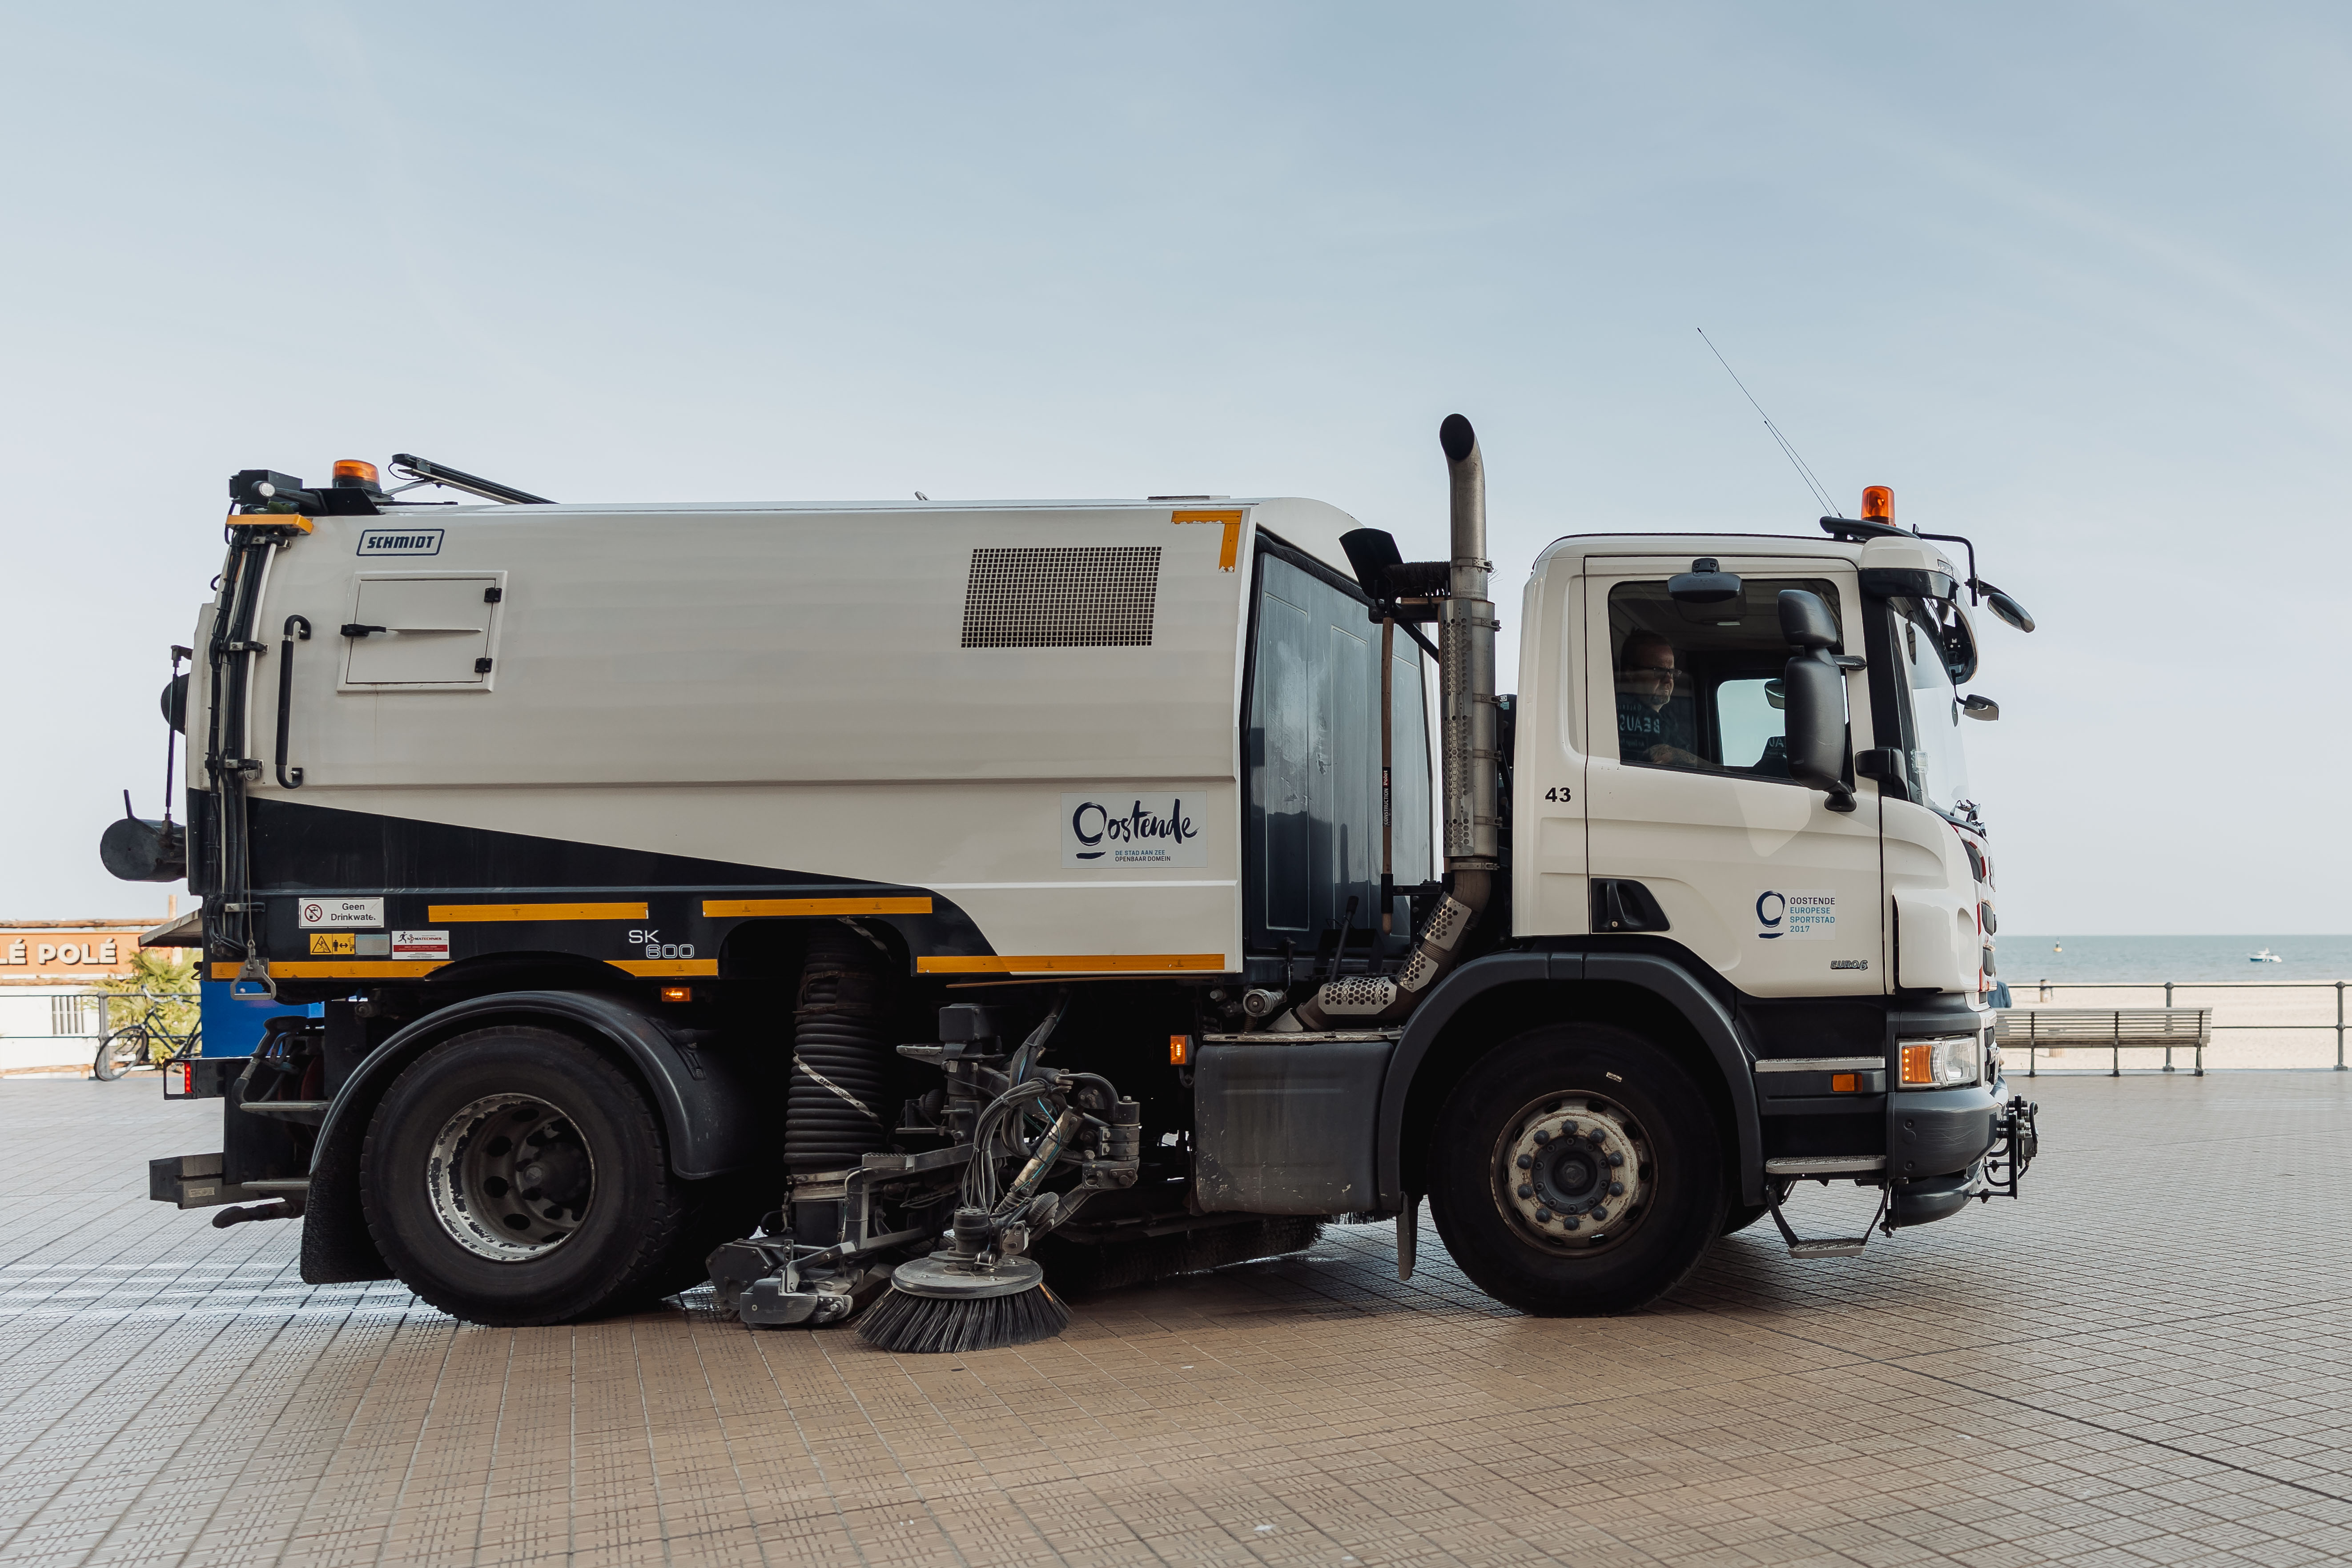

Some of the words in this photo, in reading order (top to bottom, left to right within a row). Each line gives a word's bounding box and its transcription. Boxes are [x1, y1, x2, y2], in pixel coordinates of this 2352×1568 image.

[367, 536, 435, 548] SCHMIDT
[1545, 787, 1571, 802] 43
[1072, 798, 1200, 847] Oostende
[629, 930, 661, 943] SK
[38, 937, 118, 965] POLÉ
[646, 944, 694, 959] 600
